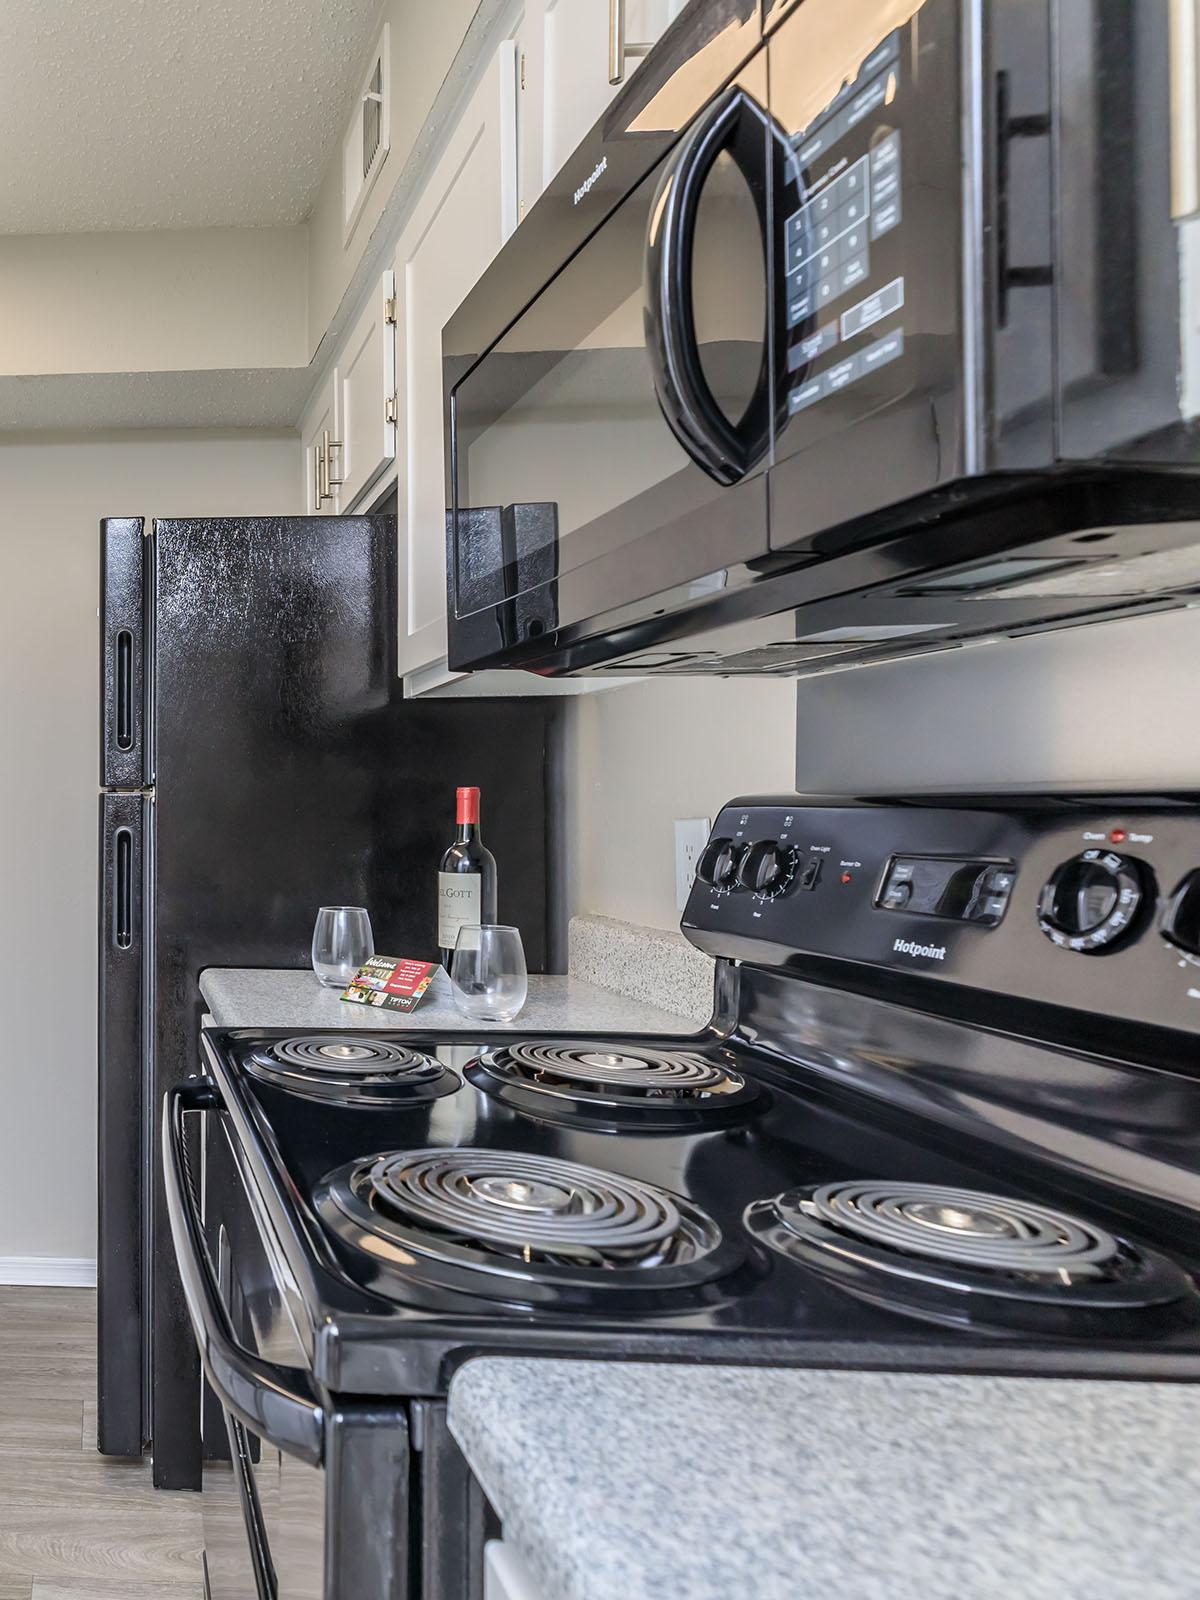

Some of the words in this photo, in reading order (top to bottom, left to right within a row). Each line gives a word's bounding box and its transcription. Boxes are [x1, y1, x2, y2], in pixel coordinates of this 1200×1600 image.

[574, 156, 607, 205] Hotpoint
[893, 939, 946, 960] Hotpoint
[365, 957, 397, 969] Welcome
[389, 997, 412, 1005] TIPTON
